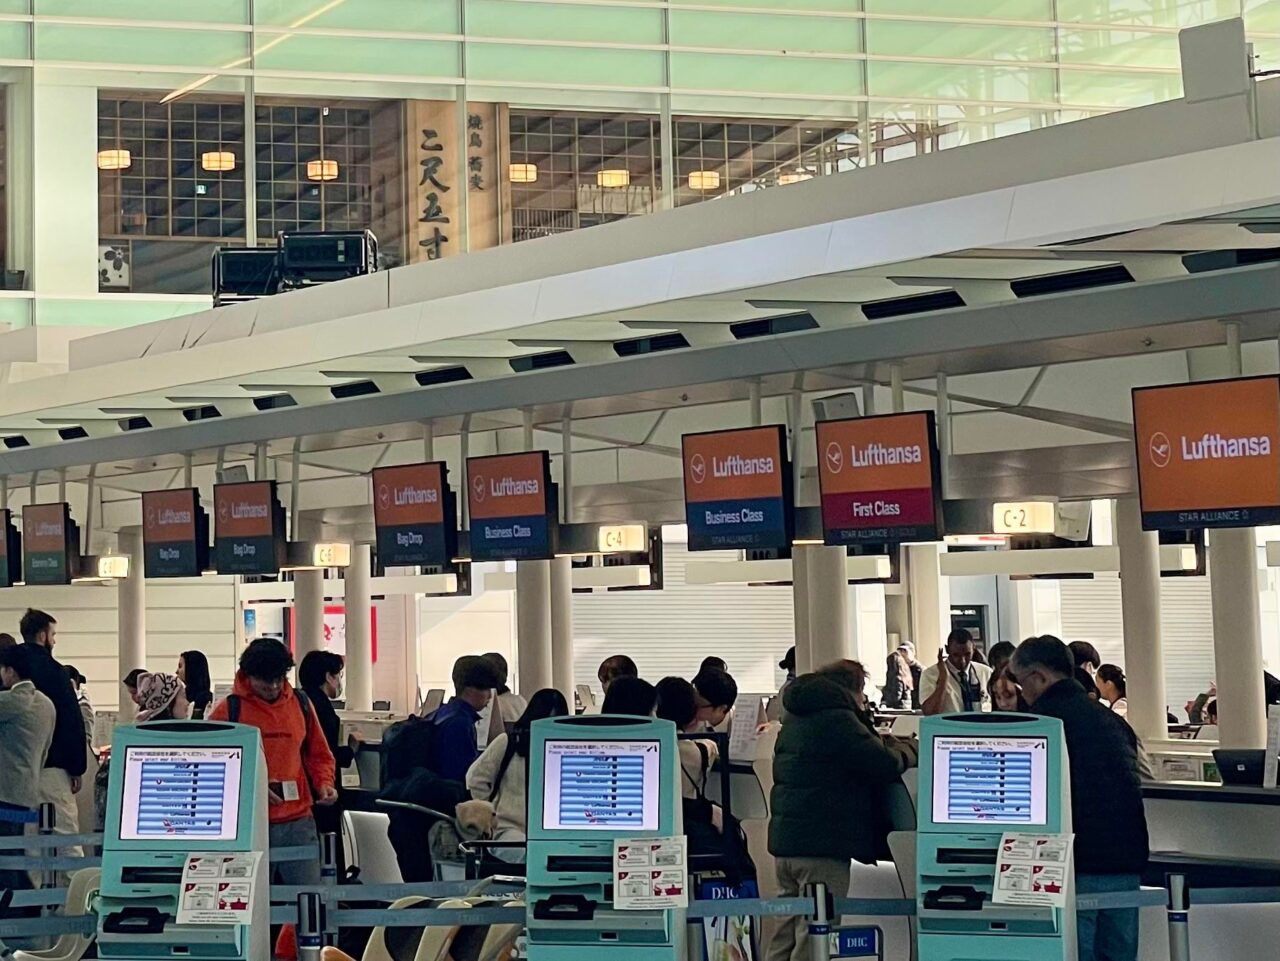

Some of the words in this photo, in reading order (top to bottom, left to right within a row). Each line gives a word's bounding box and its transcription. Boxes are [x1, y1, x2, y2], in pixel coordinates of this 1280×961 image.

[418, 128, 451, 260] 二尺五寸
[1181, 433, 1271, 460] Lufthansa
[851, 444, 921, 467] Lufthansa
[713, 456, 774, 477] Lufthansa
[490, 478, 539, 497] Lufthansa
[394, 487, 437, 506] Lufthansa
[158, 509, 191, 525] Lufthansa
[231, 502, 268, 518] Lufthansa
[705, 511, 740, 525] Business
[741, 509, 764, 522] Class
[853, 503, 873, 517] First
[874, 502, 900, 515] Class
[1178, 512, 1199, 522] STAR
[1200, 510, 1240, 521] ALLIANCE
[397, 533, 409, 547] Bag
[409, 533, 423, 547] Drop
[485, 526, 513, 539] Business
[513, 526, 531, 538] Class
[841, 530, 857, 539] STAR
[857, 529, 888, 538] ALLIANCE
[159, 548, 169, 560] Bag
[233, 544, 244, 557] Bag
[243, 544, 256, 556] Drop
